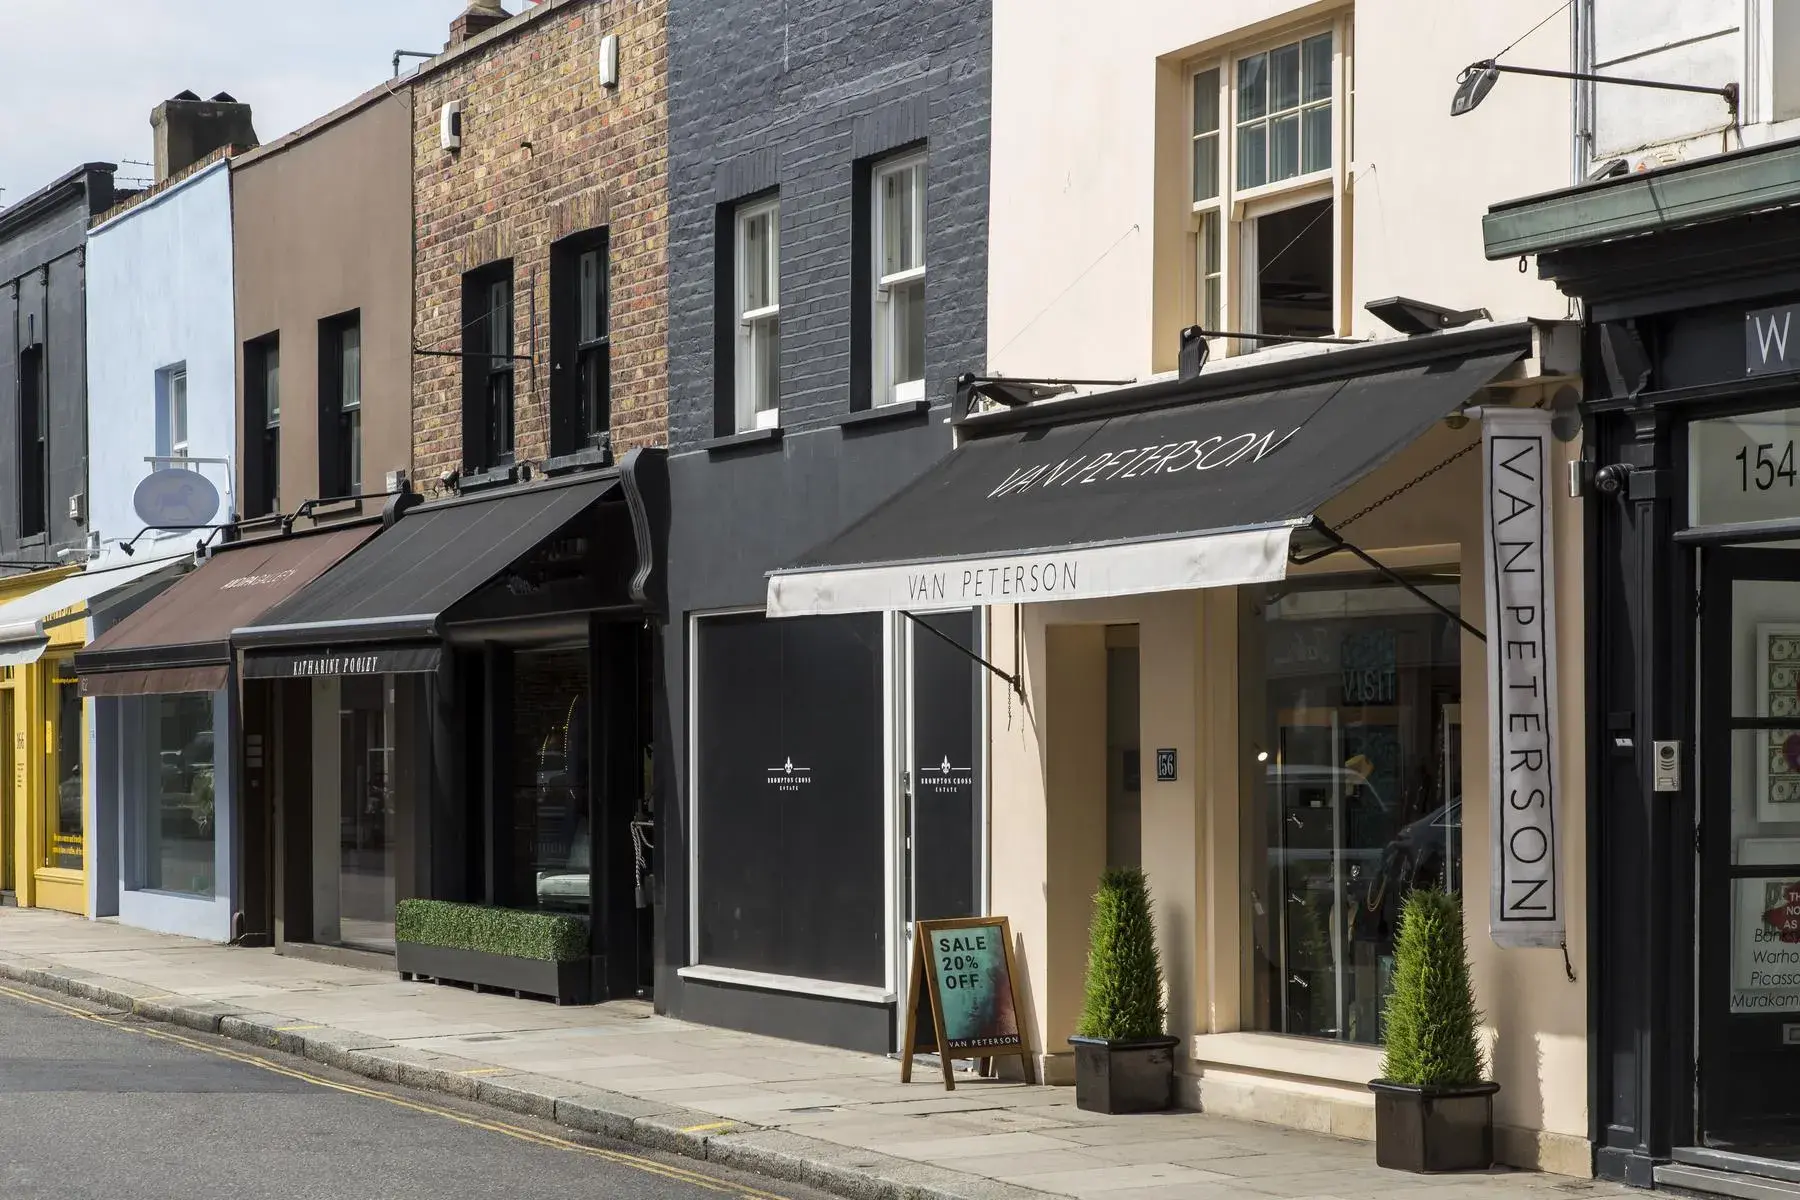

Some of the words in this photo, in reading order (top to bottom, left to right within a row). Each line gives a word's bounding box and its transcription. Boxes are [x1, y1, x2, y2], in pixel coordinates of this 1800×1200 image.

[986, 455, 1085, 498] VAN
[1079, 427, 1300, 484] PETERSON
[1736, 440, 1797, 491] 154
[1499, 446, 1536, 573] VAN
[908, 572, 946, 601] VAN
[962, 561, 1078, 597] PETERSON
[293, 658, 340, 676] KATHARINE
[343, 656, 378, 673] POOLEY
[1158, 753, 1174, 776] 156
[1506, 605, 1549, 911] PETERSON
[794, 776, 811, 784] CROSS
[953, 777, 972, 785] CROSS
[940, 936, 987, 952] SALE
[942, 955, 979, 971] 20%
[945, 974, 979, 989] OFF
[971, 1036, 1019, 1046] PETERSON
